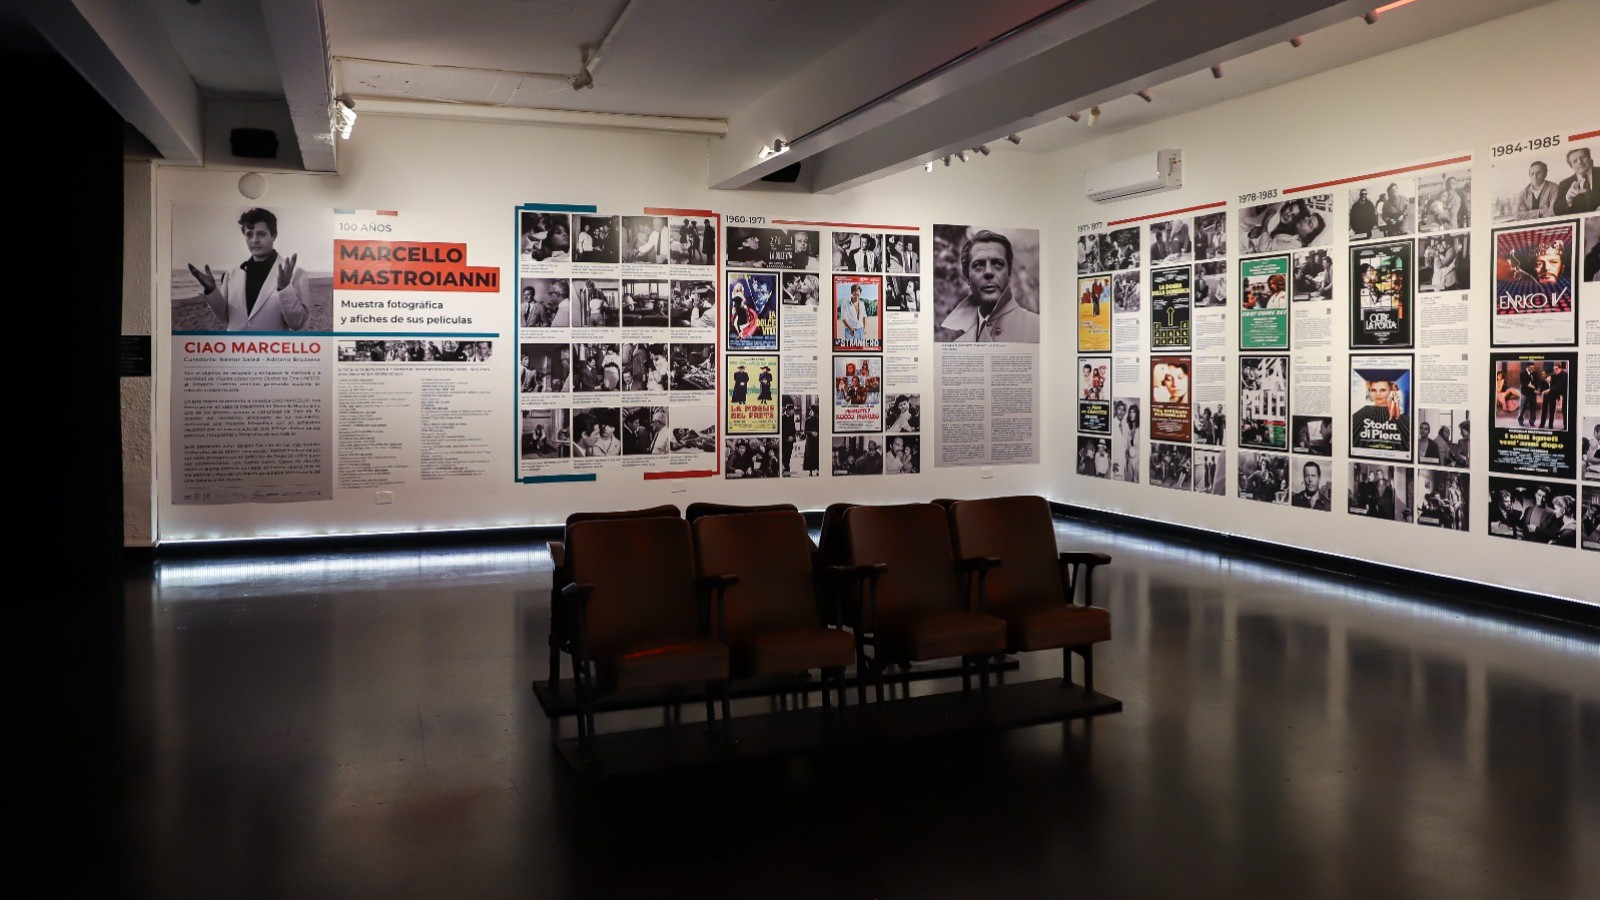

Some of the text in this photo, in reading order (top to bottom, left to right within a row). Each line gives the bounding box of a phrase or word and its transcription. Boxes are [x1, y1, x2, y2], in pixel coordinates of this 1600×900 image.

[1491, 134, 1560, 157] 1984-1985
[1238, 189, 1277, 203] 1978-1983
[726, 215, 765, 224] 1960-1971
[339, 221, 392, 232] 100 AÑOS
[340, 245, 463, 263] MARCELLO
[340, 269, 497, 287] MASTROIANNI
[341, 299, 444, 310] Muestra fotográfica
[1500, 286, 1568, 313] ENRICO IV
[340, 314, 473, 325] y afiches de sus películas
[769, 310, 776, 319] LA
[756, 319, 777, 327] DOLCE
[184, 342, 321, 354] CIAO MARCELLO
[1363, 418, 1397, 430] Storia
[1360, 429, 1402, 441] di Piera
[1532, 435, 1559, 443] ignoti
[1541, 441, 1564, 449] dopo
